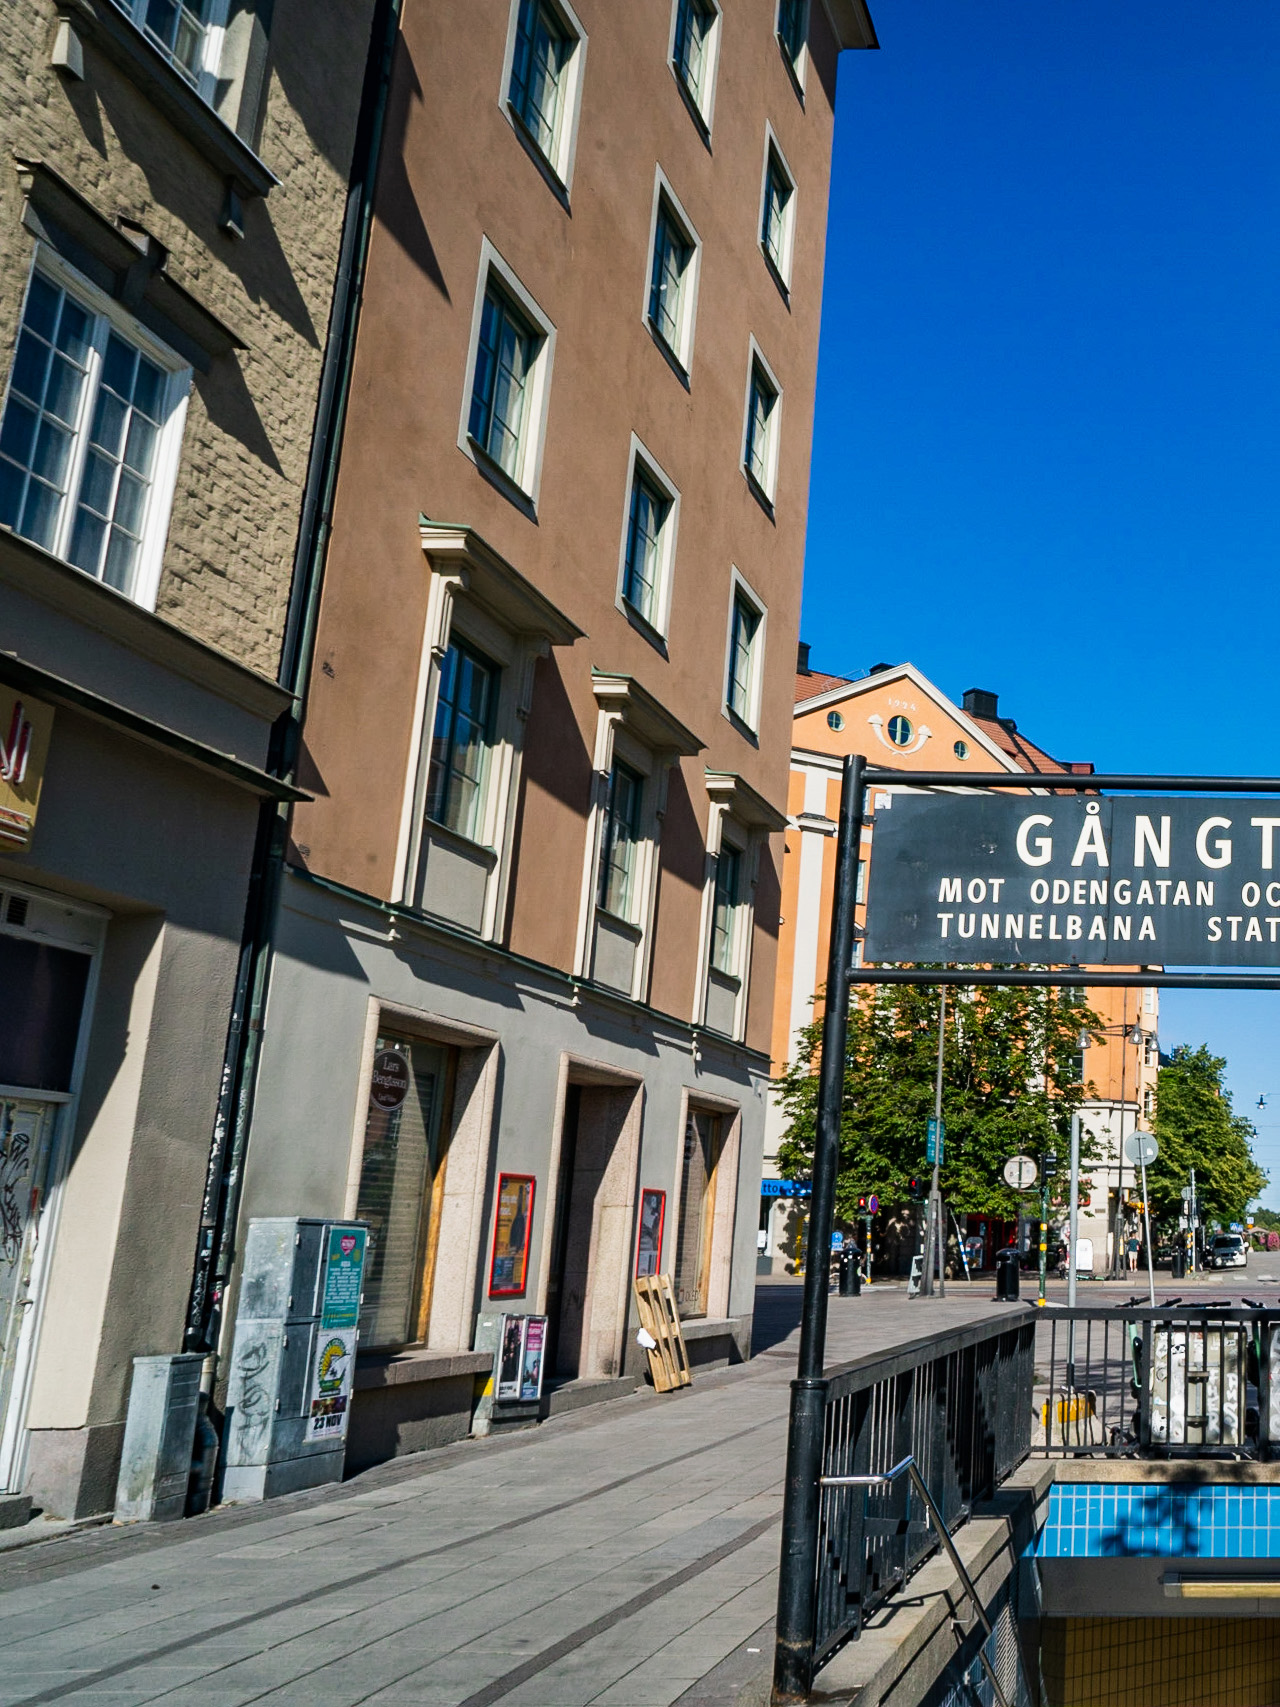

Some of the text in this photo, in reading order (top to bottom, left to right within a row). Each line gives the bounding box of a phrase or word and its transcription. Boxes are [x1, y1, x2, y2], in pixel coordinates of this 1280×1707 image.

[937, 877, 1006, 904] MOT
[1029, 878, 1215, 907] ODENGATAN
[936, 912, 1157, 941] TUNNELBANA
[313, 1413, 343, 1431] 23 NOV
